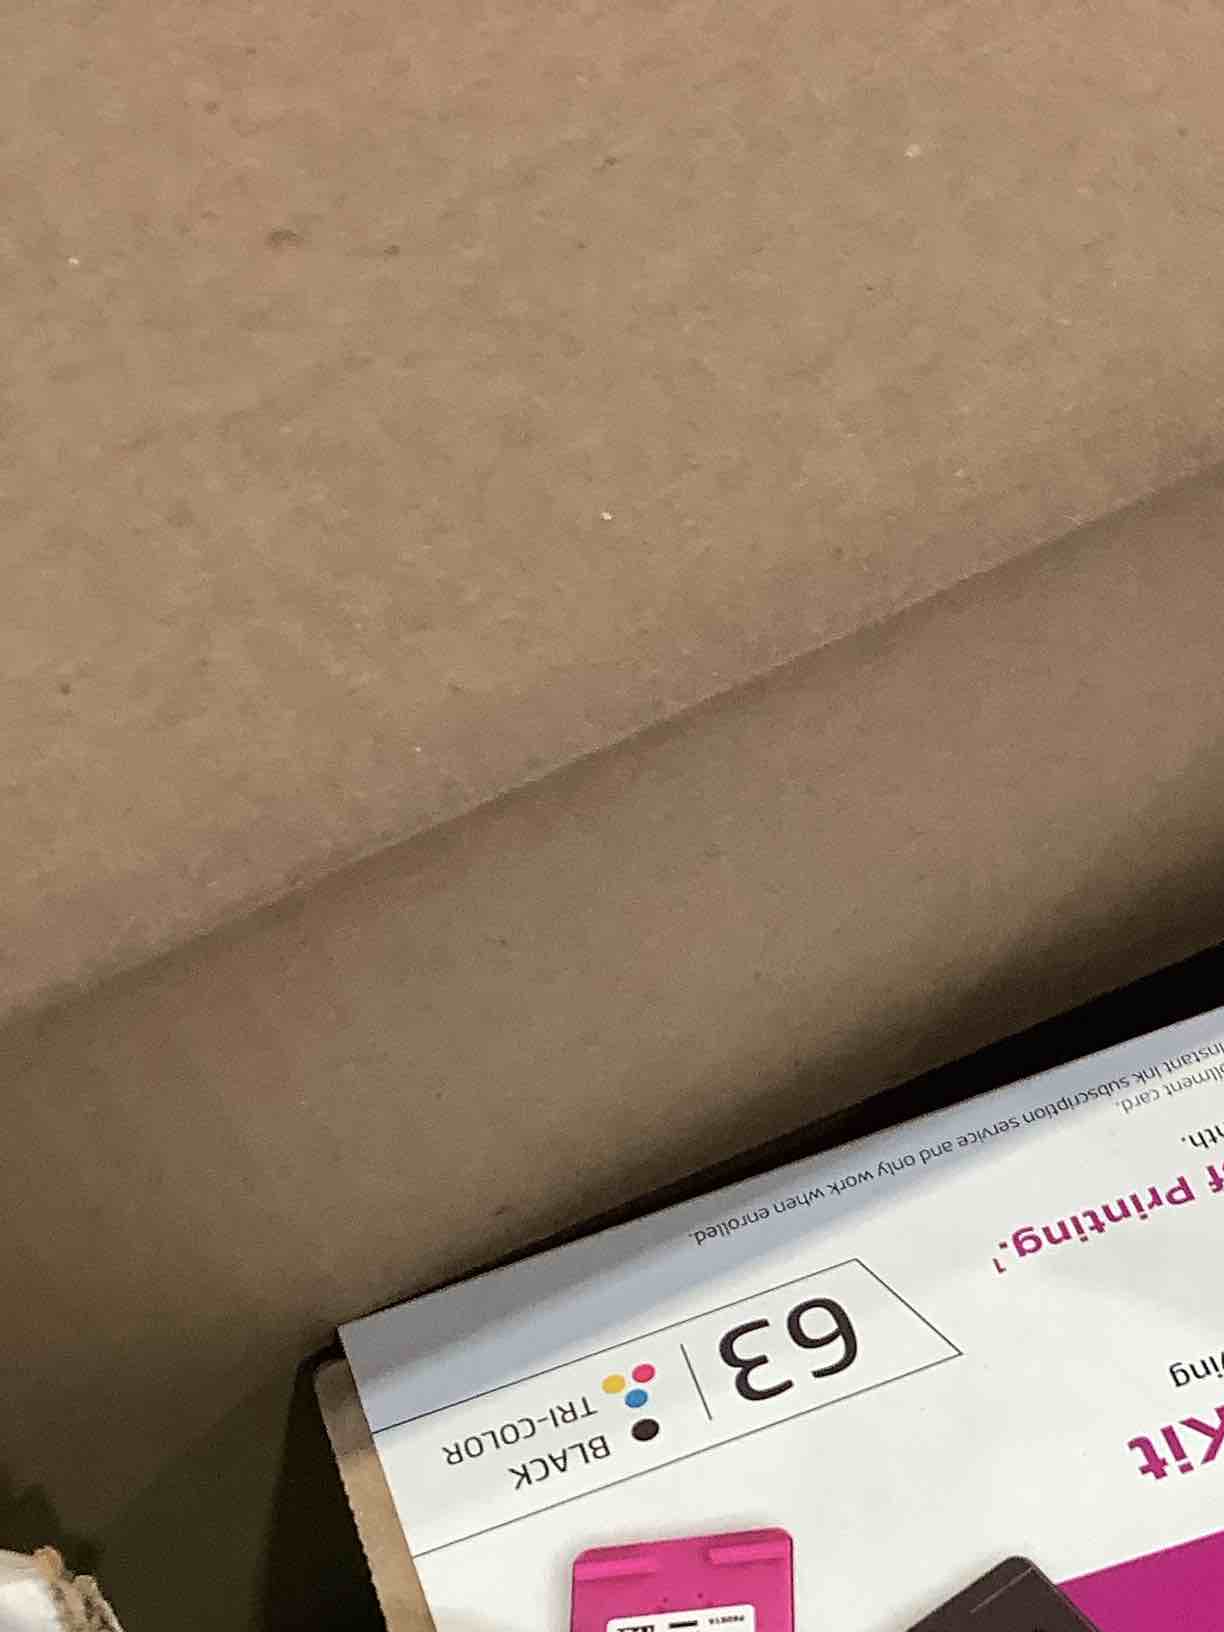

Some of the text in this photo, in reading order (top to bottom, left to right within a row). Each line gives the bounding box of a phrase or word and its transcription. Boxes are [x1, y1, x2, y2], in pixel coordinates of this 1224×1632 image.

[1126, 1061, 1163, 1086] Ink
[1021, 1070, 1131, 1127] subscription
[1109, 1087, 1161, 1115] card.
[955, 1113, 1022, 1148] service
[874, 1151, 917, 1184] only
[917, 1137, 955, 1168] and
[767, 1184, 827, 1217] when
[821, 1169, 875, 1202] work
[685, 1201, 771, 1247] enrolled.
[718, 1297, 858, 1402] 63
[441, 1395, 599, 1466] TRI-COLOR
[507, 1434, 611, 1491] BLACK
